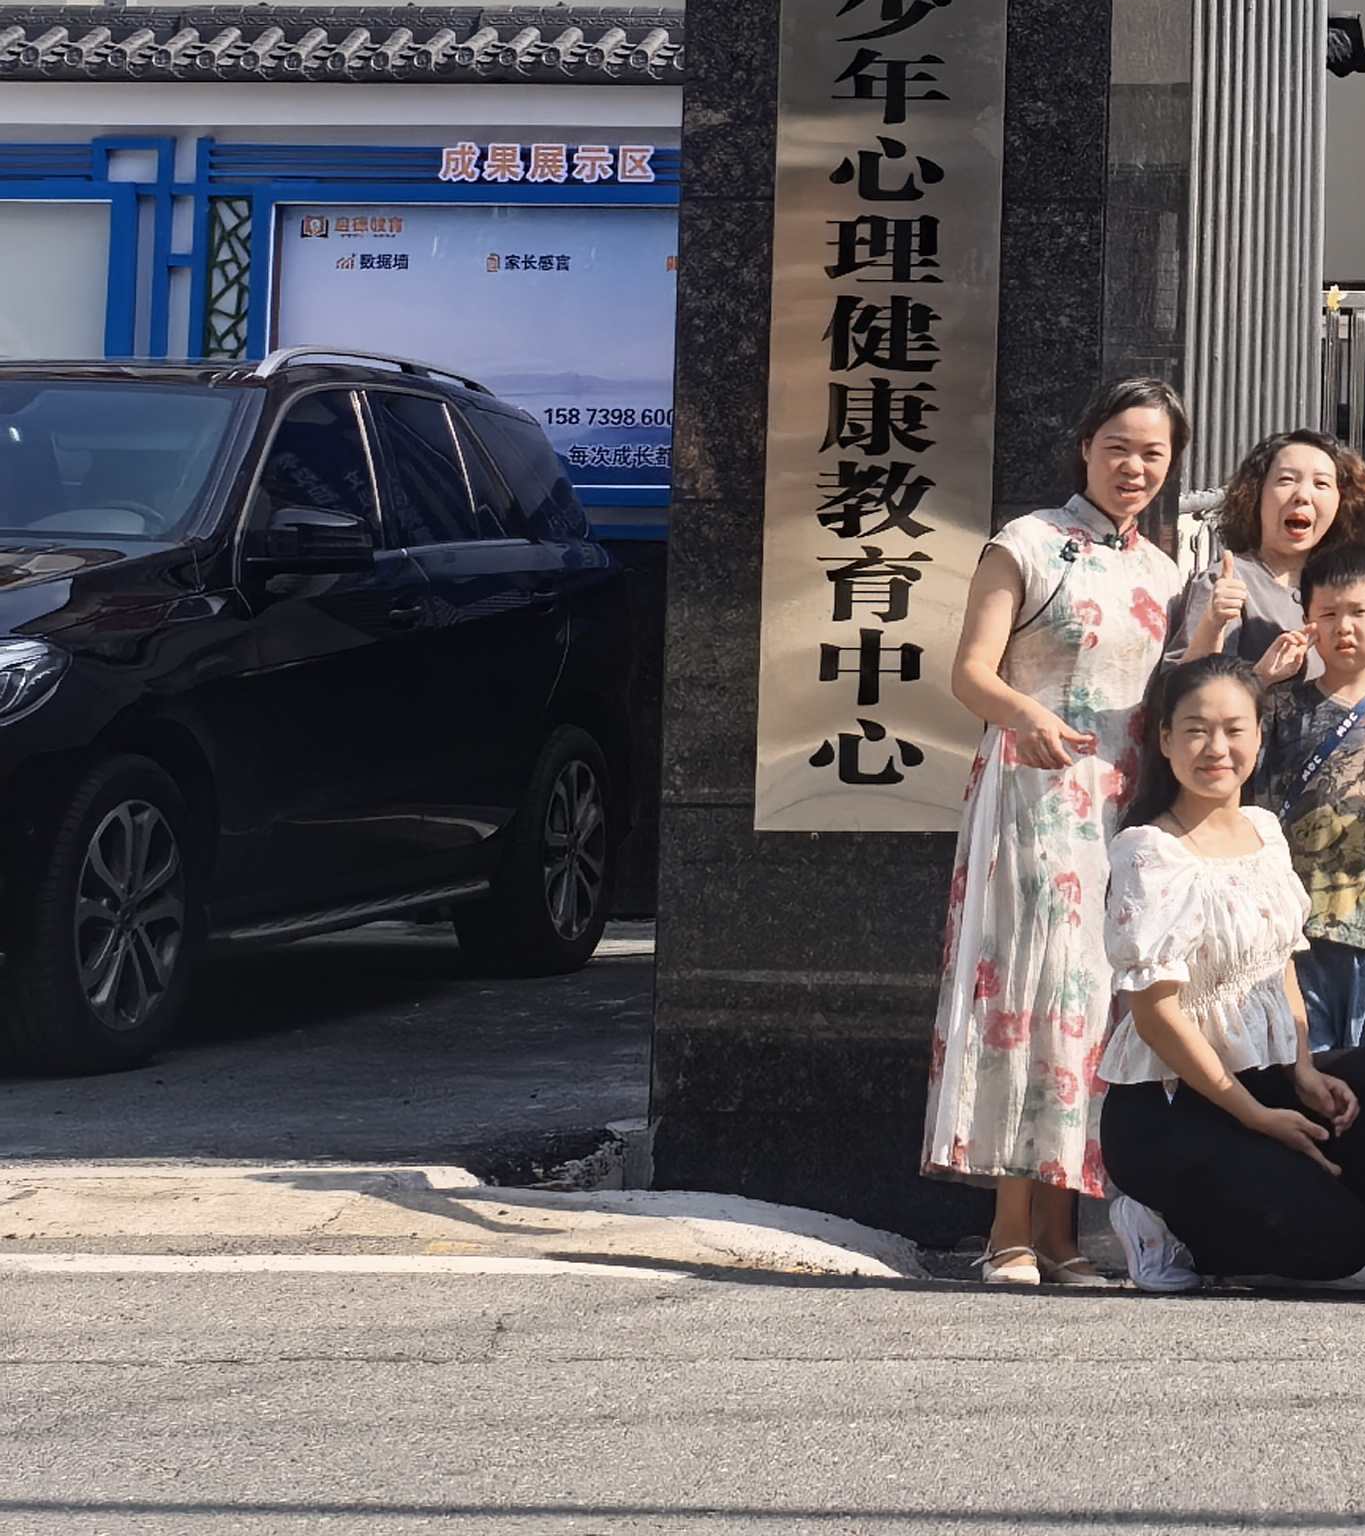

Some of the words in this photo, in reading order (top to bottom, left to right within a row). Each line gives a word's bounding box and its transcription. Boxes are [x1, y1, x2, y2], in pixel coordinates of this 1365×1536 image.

[439, 142, 656, 182] 成果展示区
[360, 253, 410, 270] 数据墙
[544, 408, 581, 426] 158
[586, 408, 636, 427] 7398
